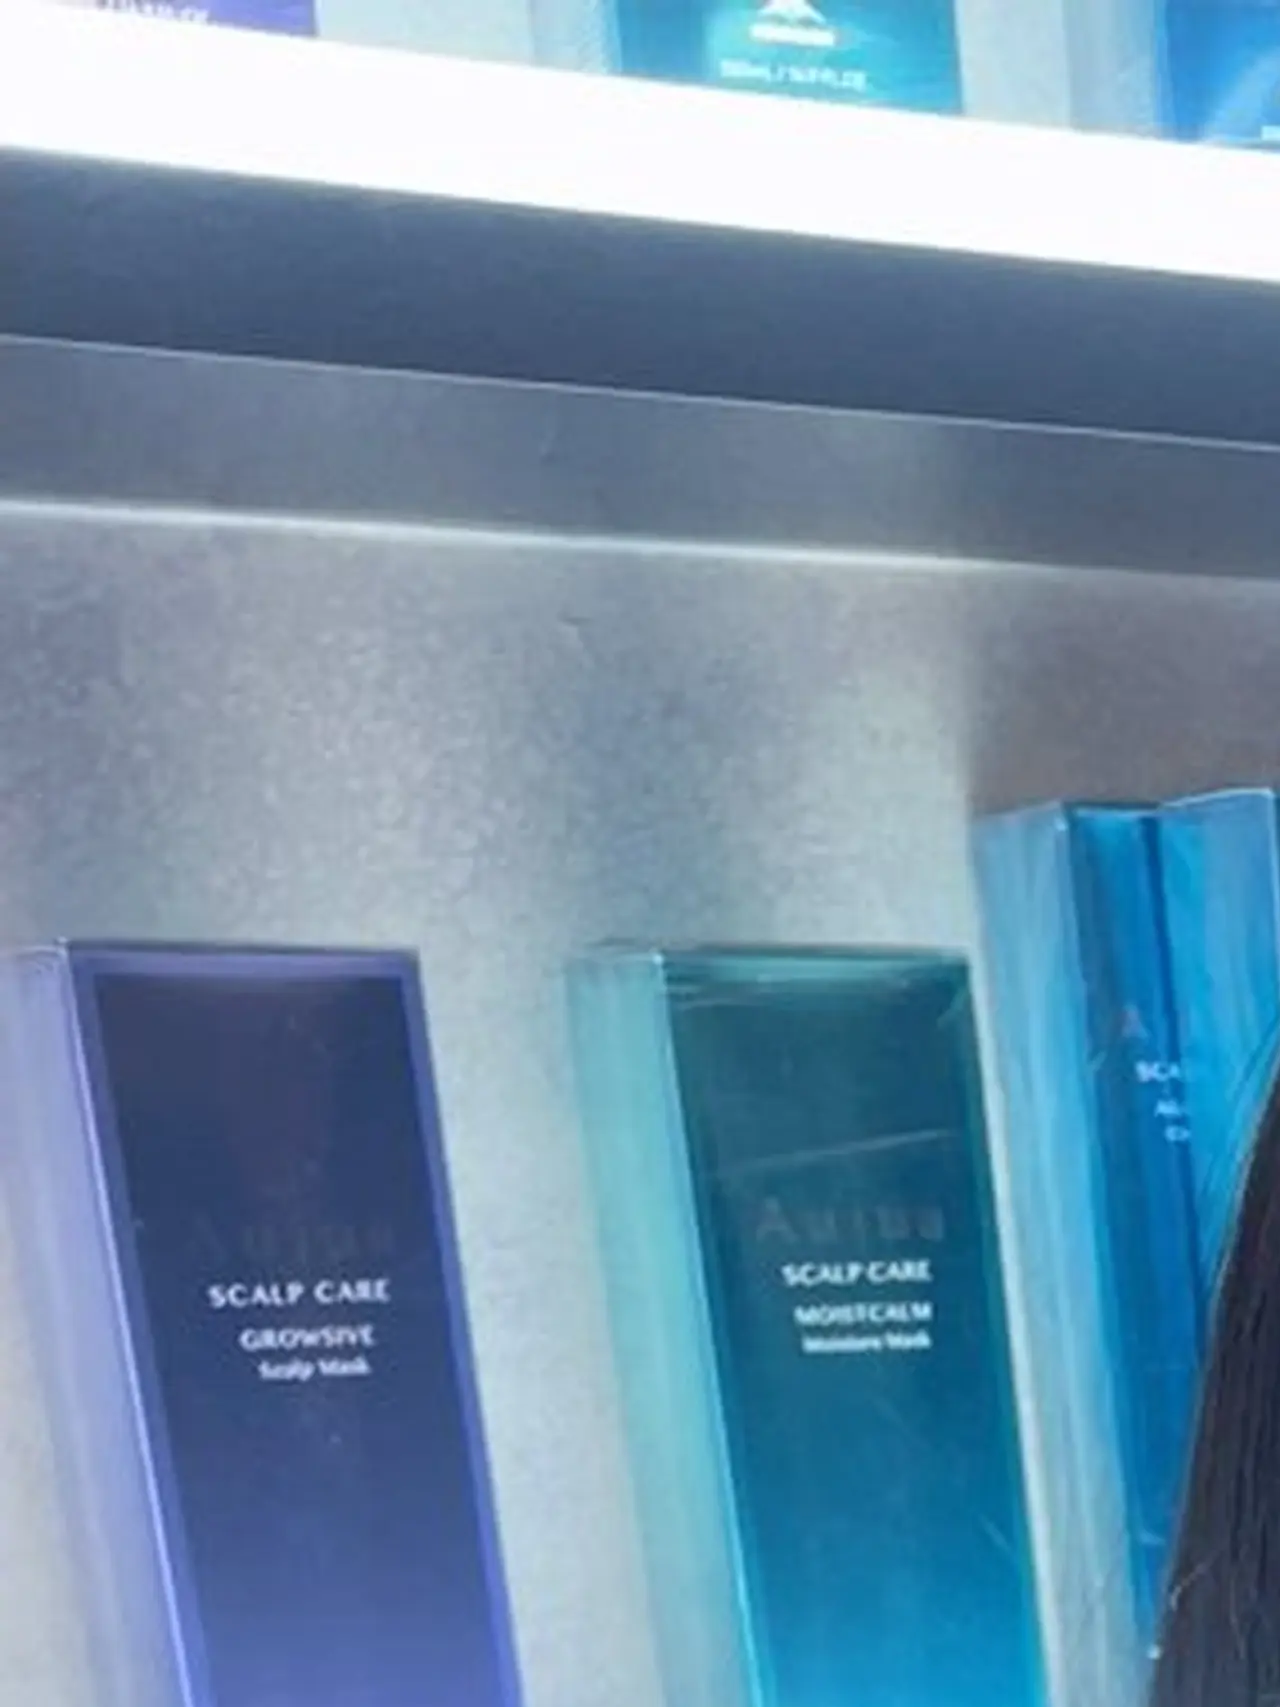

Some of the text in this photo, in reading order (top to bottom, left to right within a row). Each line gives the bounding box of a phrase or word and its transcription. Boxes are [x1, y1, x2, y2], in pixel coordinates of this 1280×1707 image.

[780, 1257, 934, 1287] SCALP CARE
[206, 1277, 392, 1309] SCALP CARE
[237, 1323, 376, 1351] GROWSIVE
